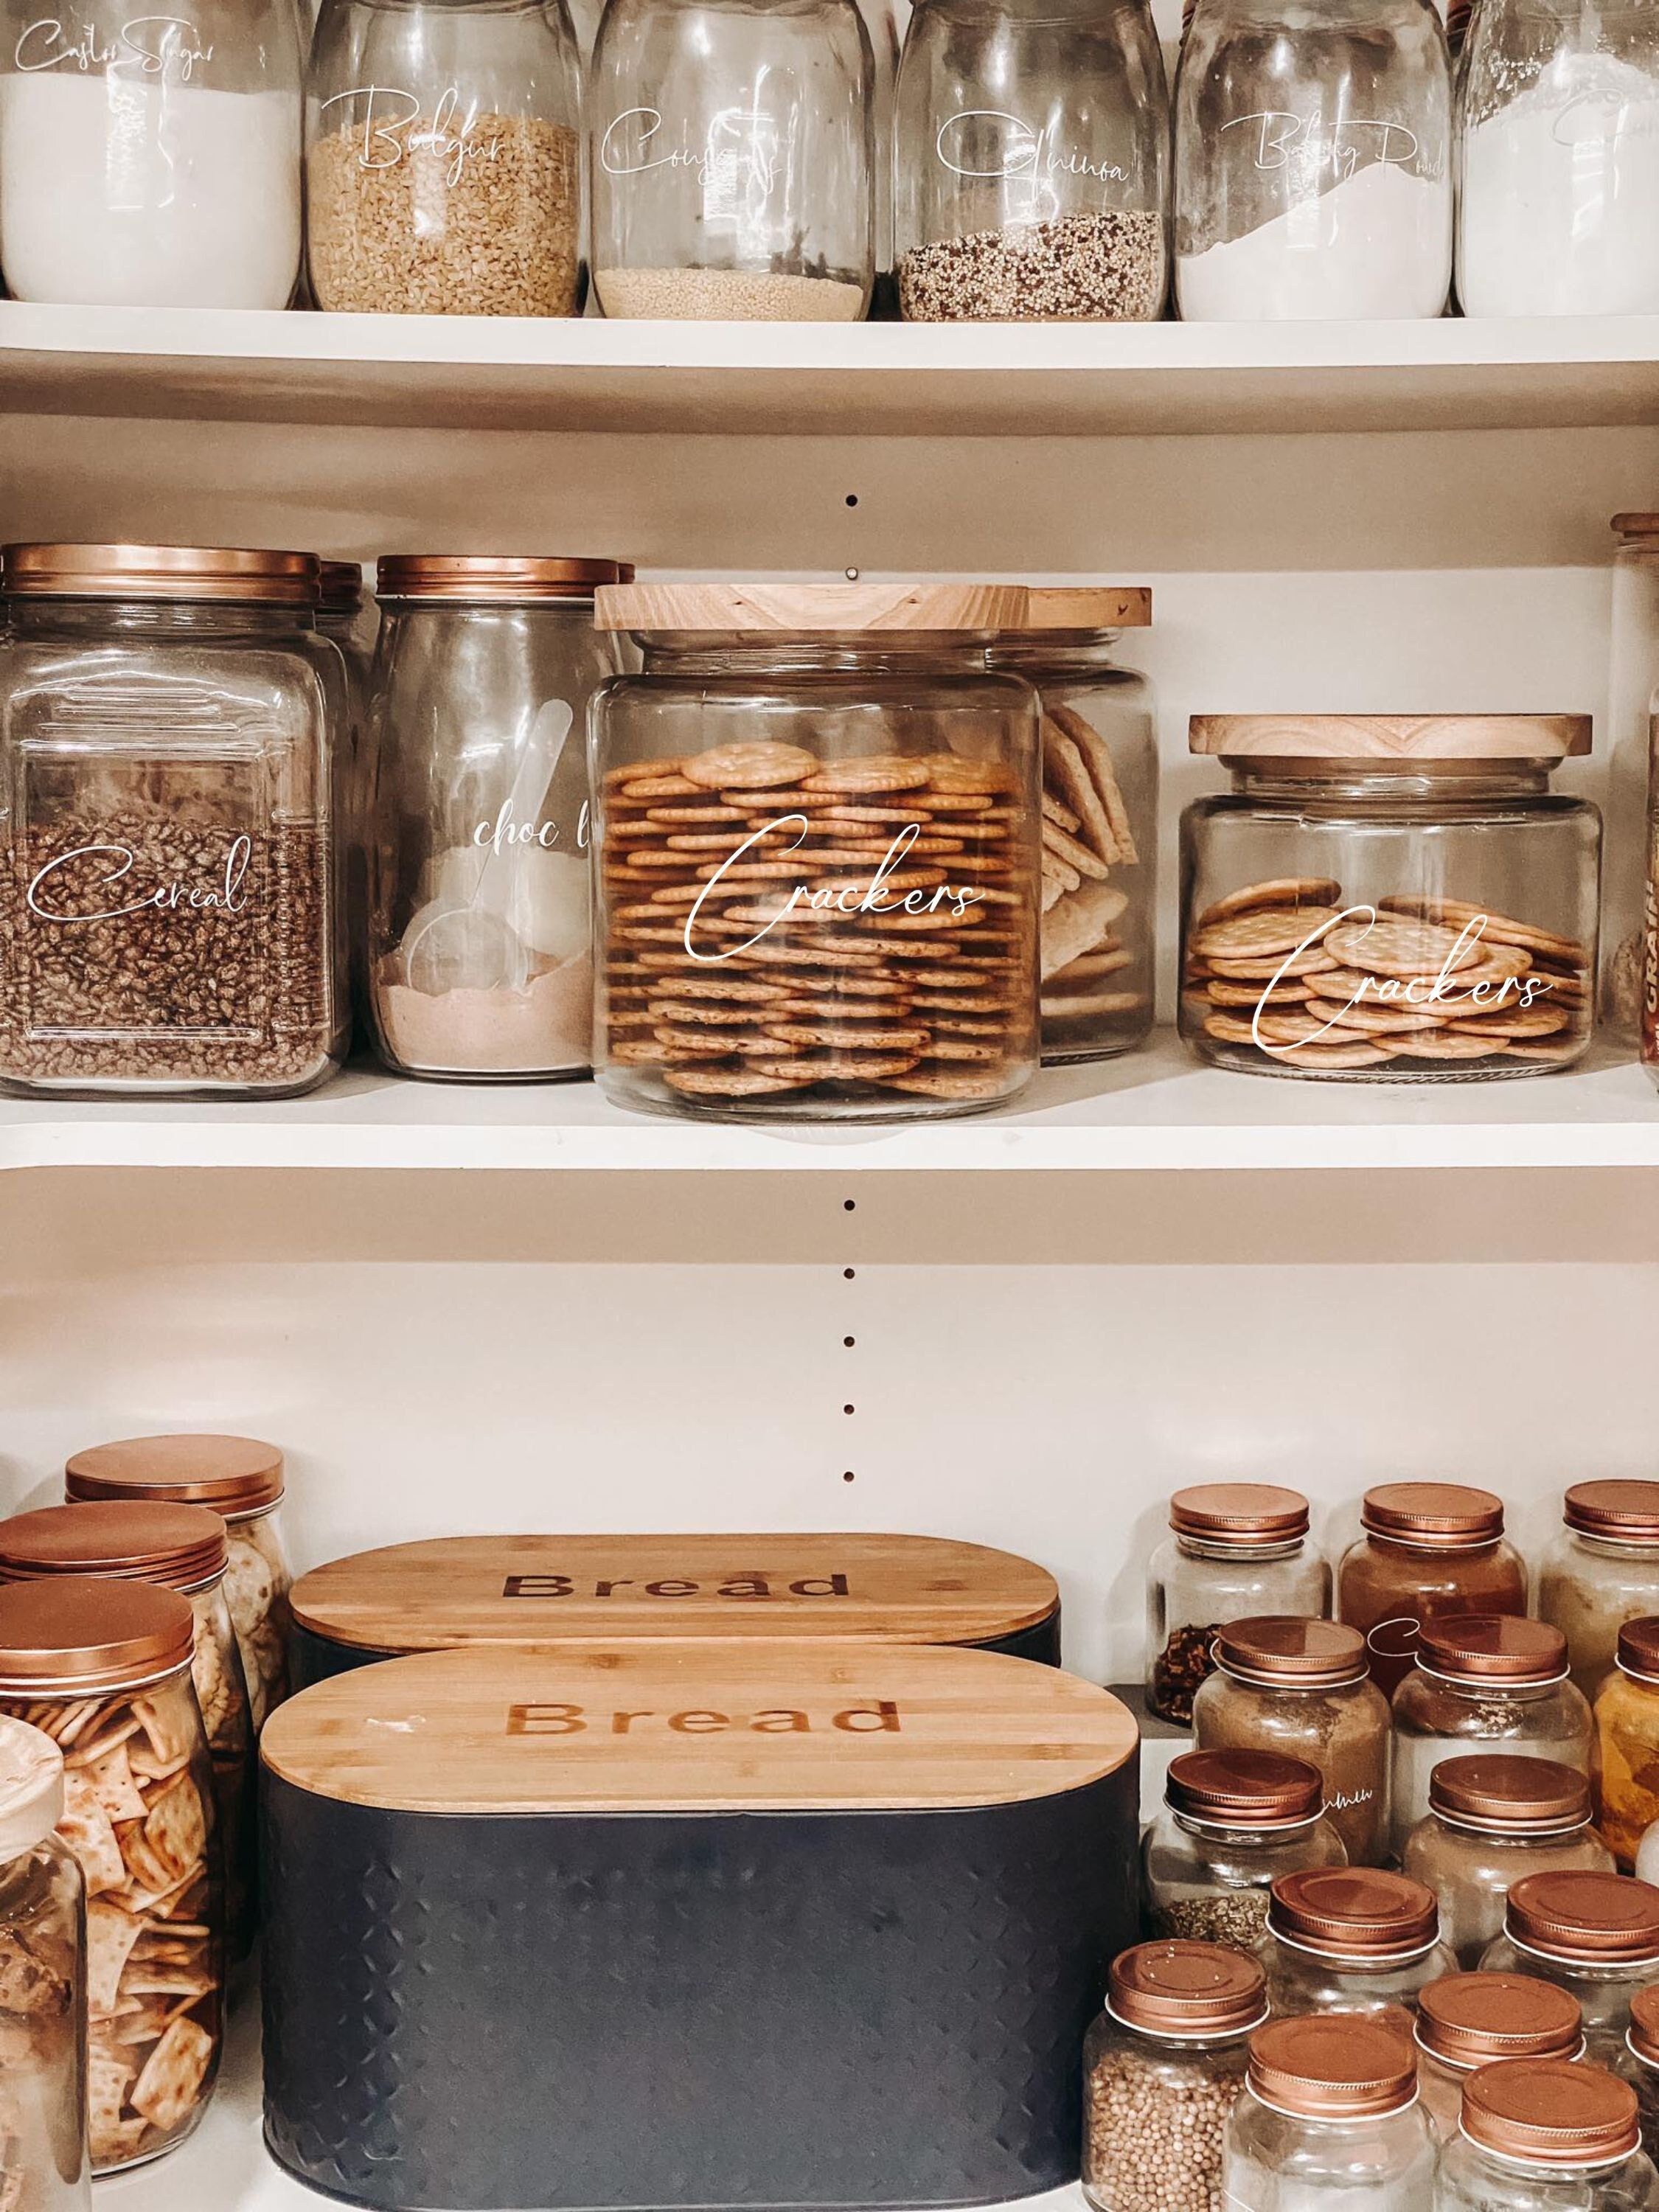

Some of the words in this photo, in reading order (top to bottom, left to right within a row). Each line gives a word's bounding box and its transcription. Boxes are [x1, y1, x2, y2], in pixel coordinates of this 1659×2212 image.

[122, 16, 215, 80] Sugar
[321, 84, 505, 187] Bulgur
[937, 111, 1130, 204] Quinoa
[1221, 111, 1360, 180] Bakng
[473, 798, 560, 856] choc
[27, 835, 251, 921] Cereal
[684, 814, 987, 961] Crackers
[1252, 905, 1554, 1052] Crackers
[502, 1573, 849, 1598] Bread
[505, 1701, 901, 1736] Bread
